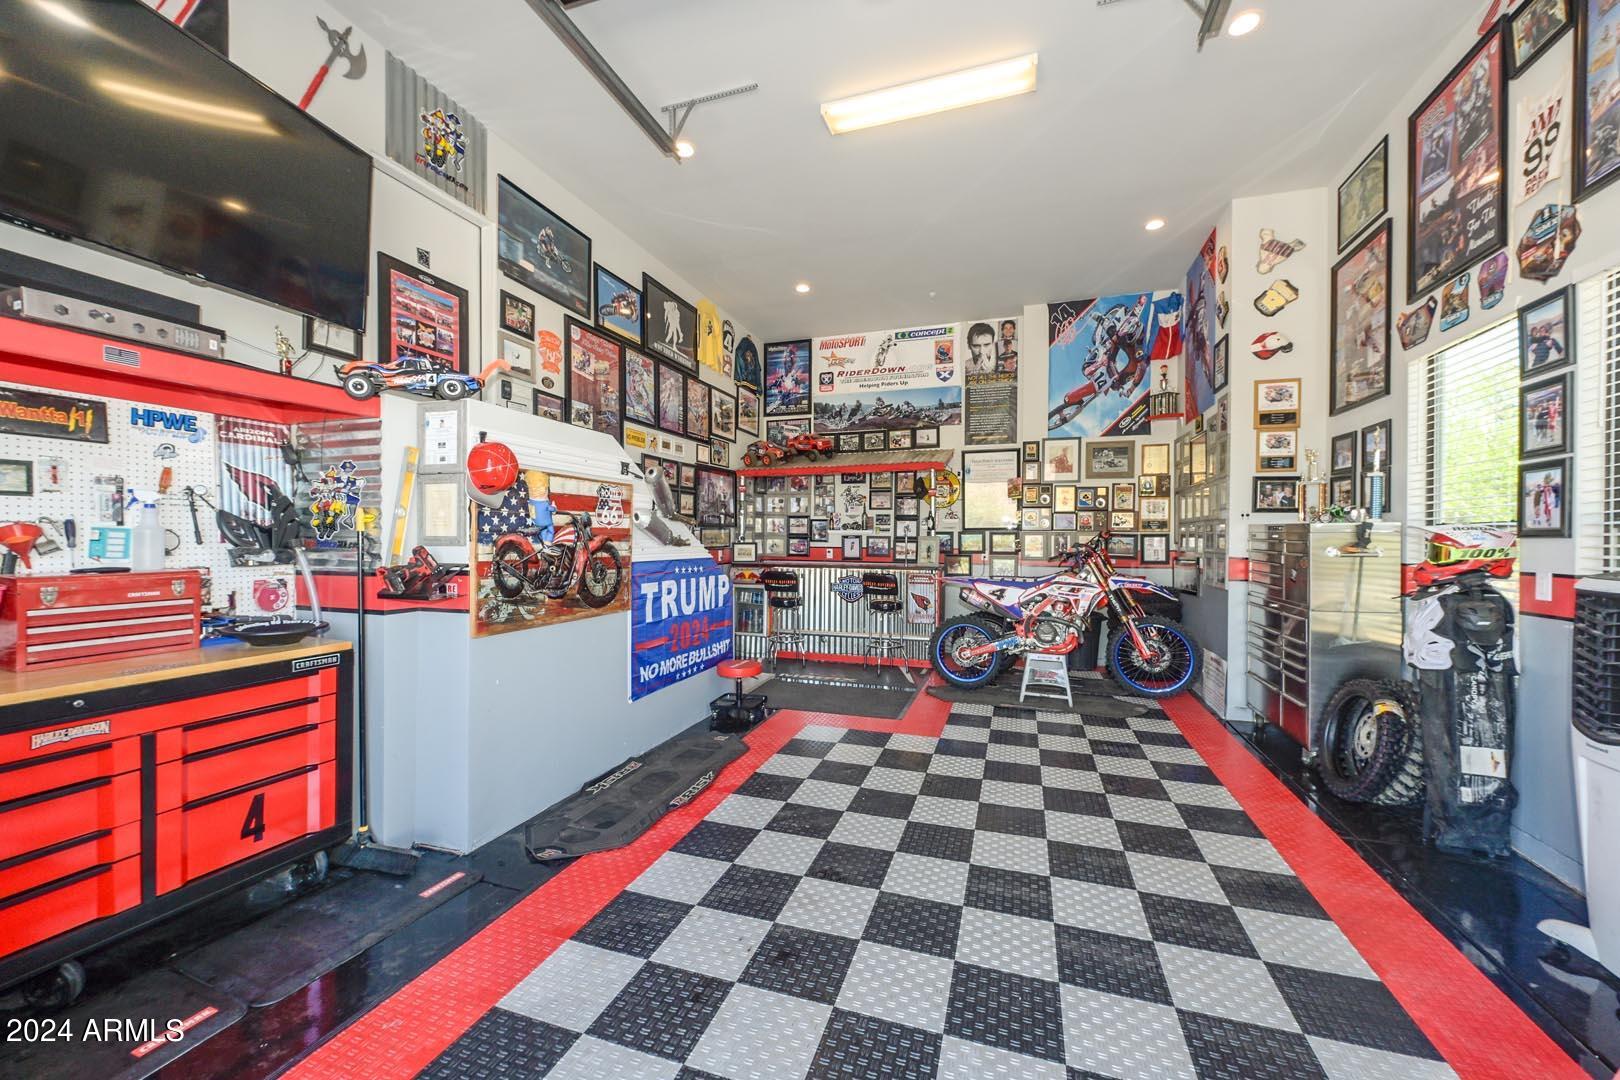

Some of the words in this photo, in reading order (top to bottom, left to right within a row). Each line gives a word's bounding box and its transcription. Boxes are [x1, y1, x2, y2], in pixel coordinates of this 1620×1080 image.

[130, 407, 198, 433] HPWE
[233, 426, 275, 437] ARIZONA
[601, 507, 619, 523] 66
[1459, 547, 1511, 558] 100%
[640, 574, 730, 624] TRUMP
[669, 616, 710, 653] 2024
[295, 656, 339, 670] CRAFTSMAN
[640, 663, 659, 683] NO
[659, 652, 689, 676] MORE
[688, 638, 731, 666] BULLSHIT
[240, 793, 266, 843] 4
